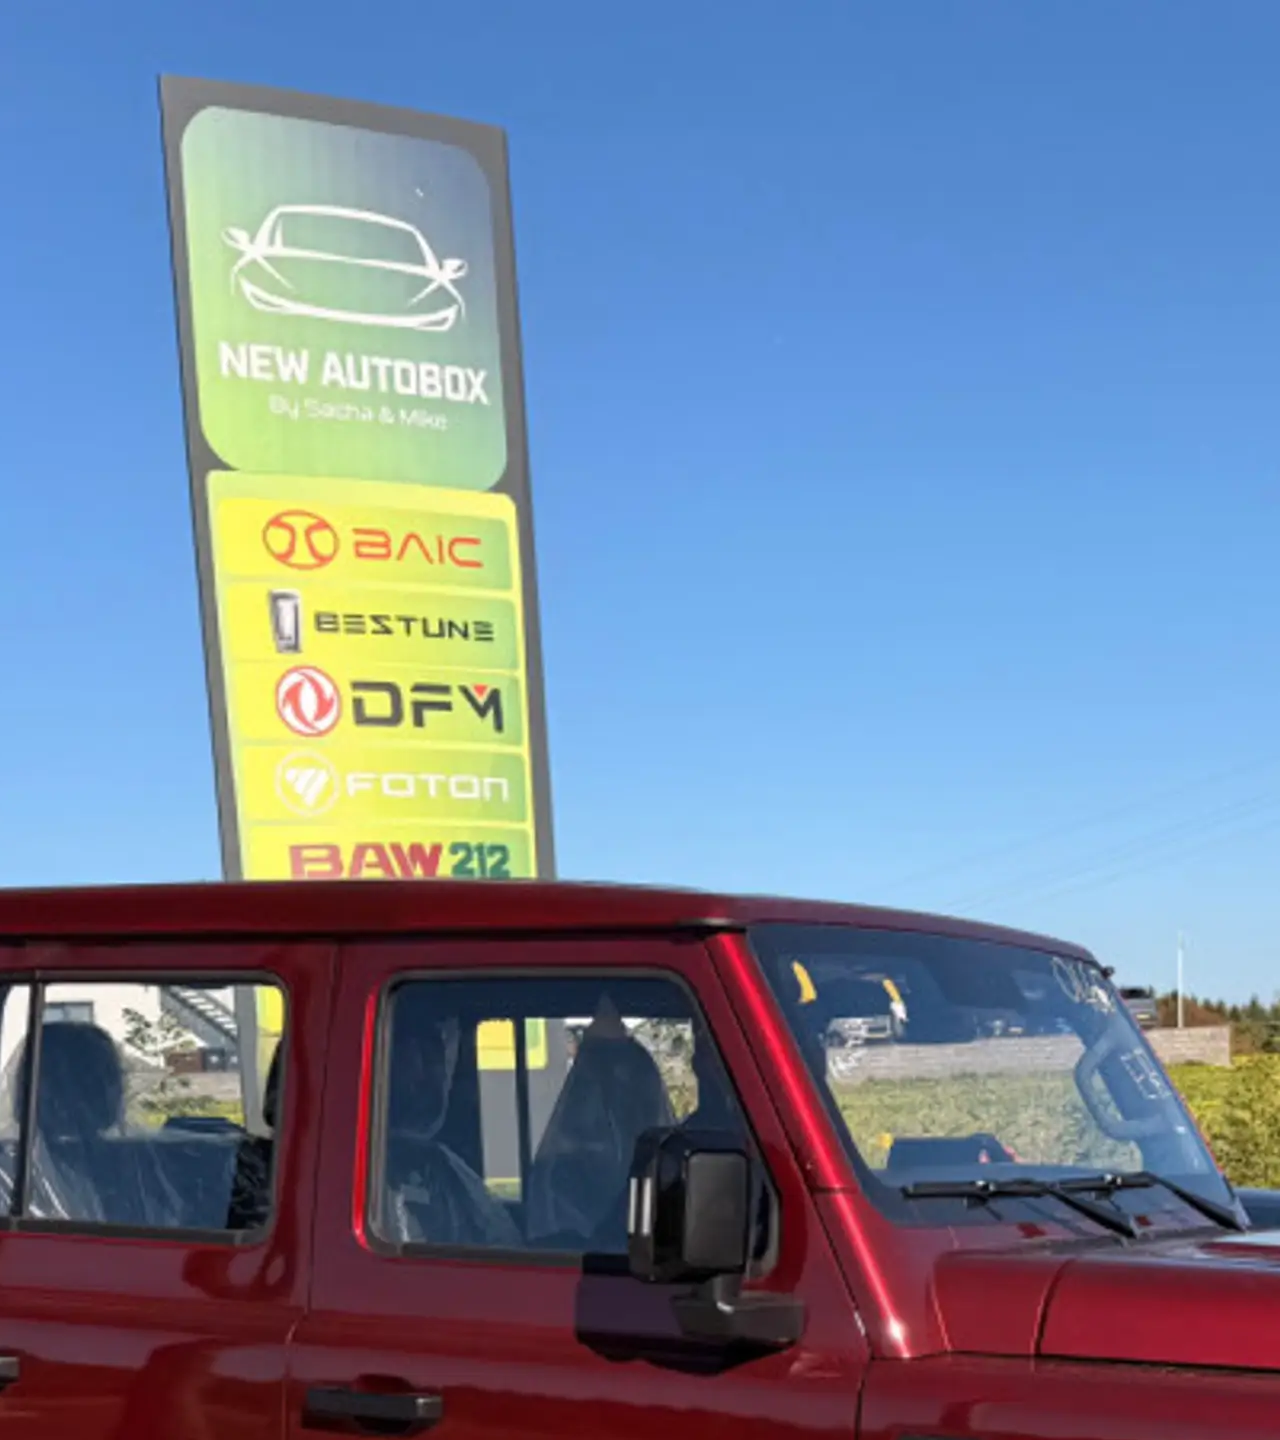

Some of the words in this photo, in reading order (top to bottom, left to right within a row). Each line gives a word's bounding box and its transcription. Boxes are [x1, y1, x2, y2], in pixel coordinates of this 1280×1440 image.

[219, 341, 310, 385] NEW
[322, 351, 491, 406] AUTOBOX
[269, 395, 300, 421] By
[304, 398, 374, 423] Sacha
[378, 407, 395, 424] &
[353, 528, 484, 568] BAIC
[314, 612, 495, 643] BESTUNE
[350, 681, 505, 733] DFM
[346, 773, 509, 803] FOTON
[289, 843, 443, 880] BAW
[449, 843, 512, 880] 212
